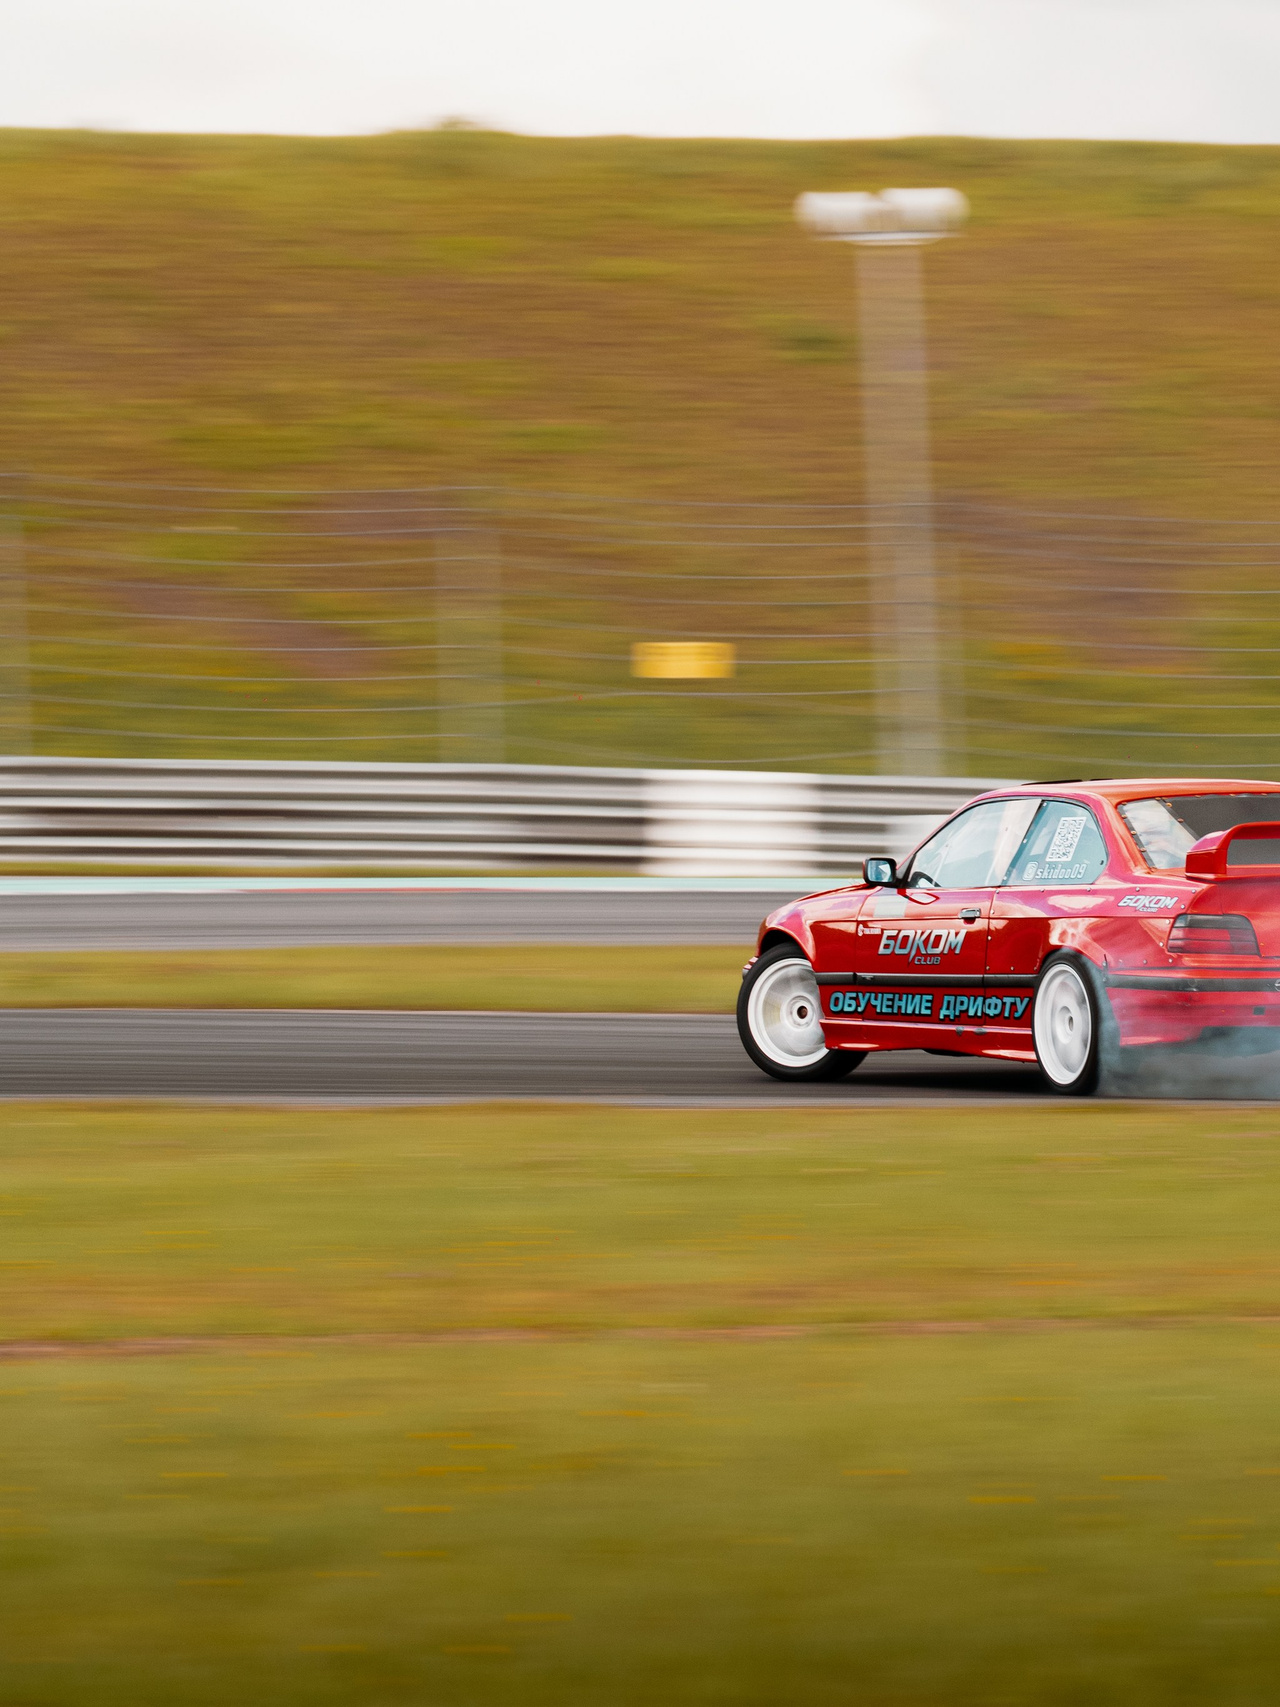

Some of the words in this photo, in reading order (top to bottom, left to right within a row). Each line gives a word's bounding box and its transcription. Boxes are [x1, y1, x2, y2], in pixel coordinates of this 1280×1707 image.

[1022, 861, 1087, 881] @skidoo09
[1117, 895, 1179, 910] БОКОМ
[877, 929, 967, 962] БОКОМ
[914, 956, 941, 965] CLUB
[829, 991, 934, 1017] ОБУЧЕНИЕ
[939, 995, 1032, 1021] ДРИФТУ
